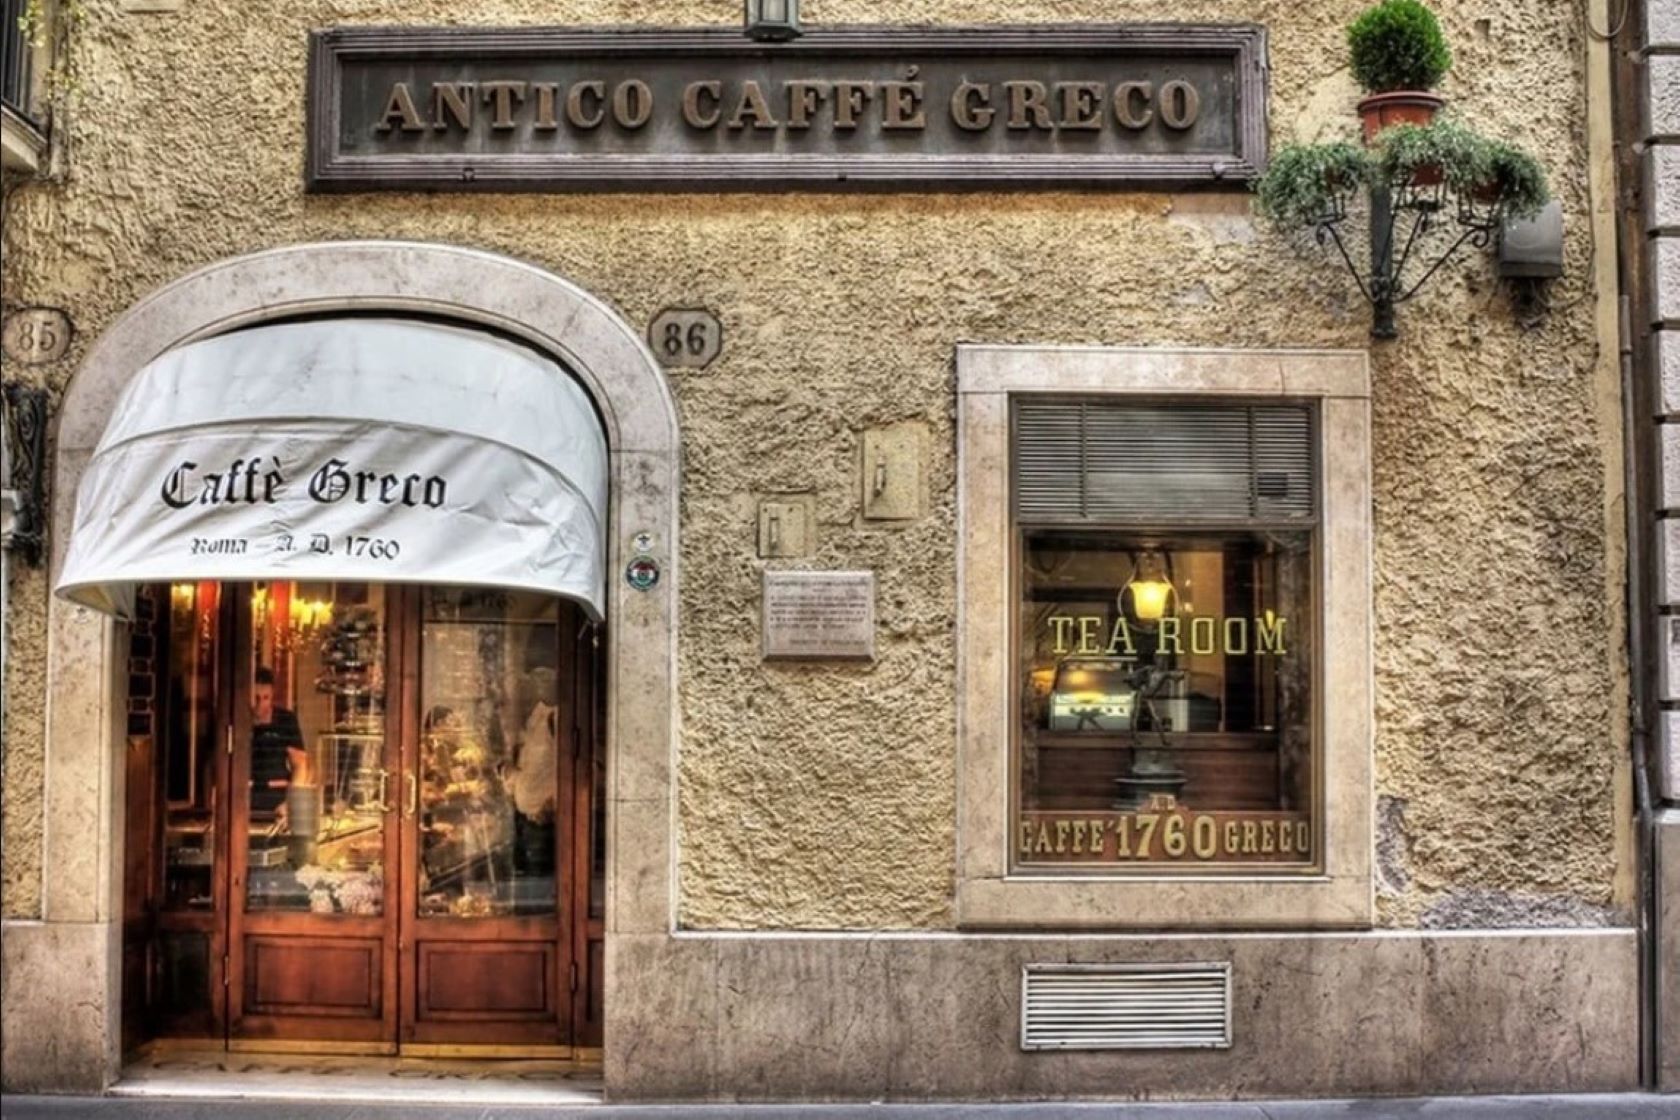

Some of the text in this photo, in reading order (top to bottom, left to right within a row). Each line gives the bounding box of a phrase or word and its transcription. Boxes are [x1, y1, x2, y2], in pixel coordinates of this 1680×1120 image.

[374, 64, 1200, 132] ANTICO CAFFÉ GRECO
[19, 320, 56, 352] 85
[663, 322, 707, 357] 86
[160, 456, 447, 510] Caffè Greco
[190, 536, 248, 556] Roma
[309, 532, 334, 556] D.
[345, 535, 401, 561] 1760
[1047, 616, 1288, 655] TEA ROOM
[1115, 813, 1218, 859] 1760
[1224, 820, 1310, 853] GRECO
